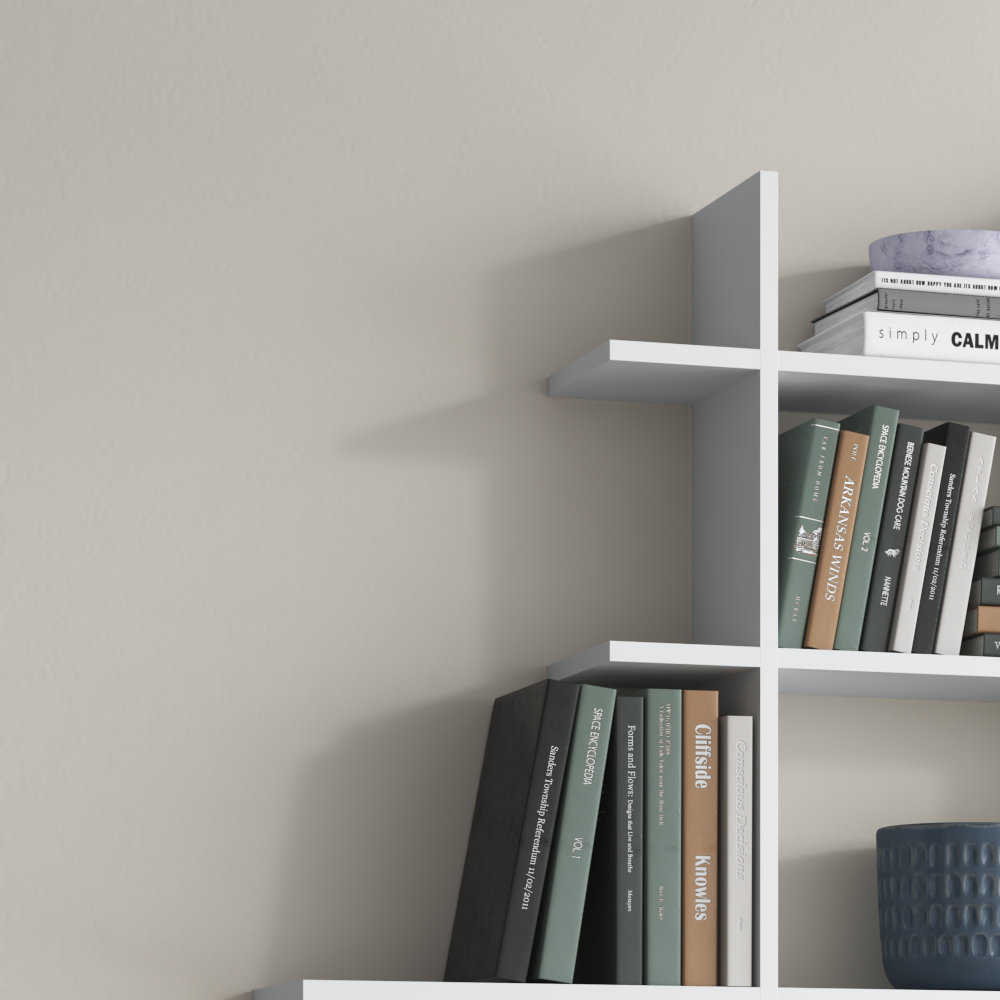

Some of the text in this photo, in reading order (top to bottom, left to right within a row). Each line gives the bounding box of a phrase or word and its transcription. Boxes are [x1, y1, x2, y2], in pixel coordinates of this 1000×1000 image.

[878, 327, 999, 350] simply CALM
[871, 424, 890, 489] SPACE ENCYCLOPEDIA
[892, 441, 915, 531] BERNESE MOUNTAIN DOG CARE
[824, 475, 855, 602] ARKANSAS WINDS
[862, 532, 871, 545] VOL
[928, 473, 956, 601] Sanders Township Referendum 11/02/2011
[879, 575, 892, 607] NANNETTE
[582, 707, 603, 785] SPACE ENCYCLOPEDIA
[627, 725, 636, 751] Forms
[627, 752, 637, 769] and
[694, 723, 712, 789] Cliffside
[625, 799, 634, 819] Designs
[627, 770, 637, 797] Flows:
[735, 740, 748, 881] Conscious Decisions
[521, 745, 559, 910] Sanders Township Referendum 11/02/2011
[572, 837, 584, 853] VOL
[694, 855, 711, 921] Knowles
